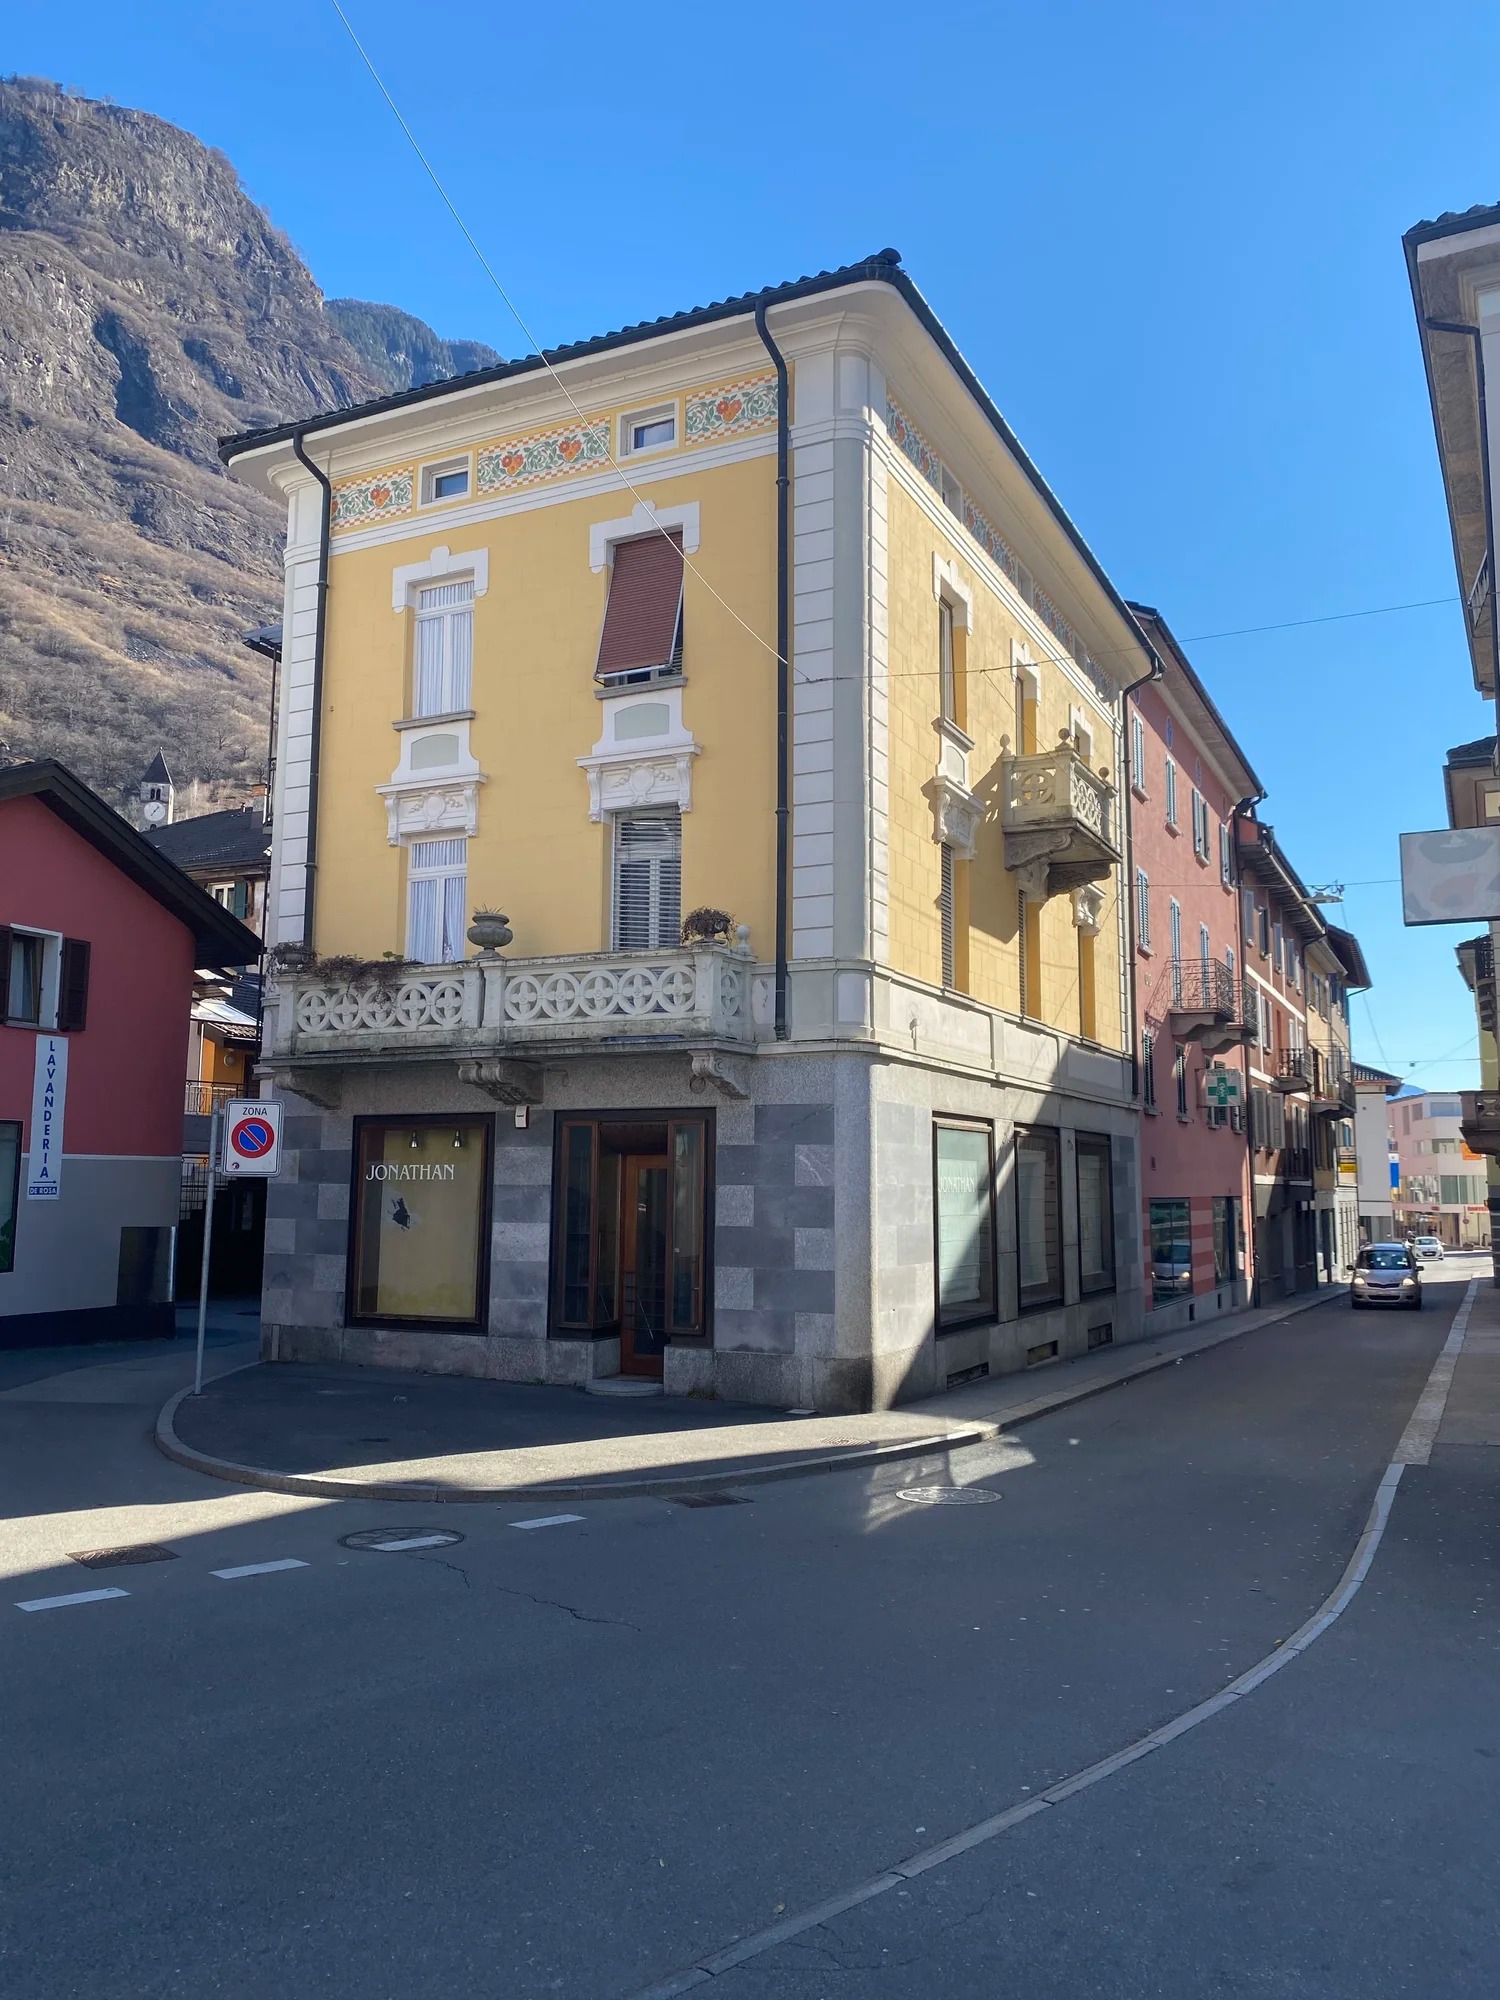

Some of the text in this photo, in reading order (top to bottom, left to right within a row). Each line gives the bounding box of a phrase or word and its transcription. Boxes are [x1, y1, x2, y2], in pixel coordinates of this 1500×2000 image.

[40, 1040, 56, 1178] LAVANDERIA
[242, 1107, 268, 1116] ZONA
[365, 1164, 455, 1181] JONATHAN
